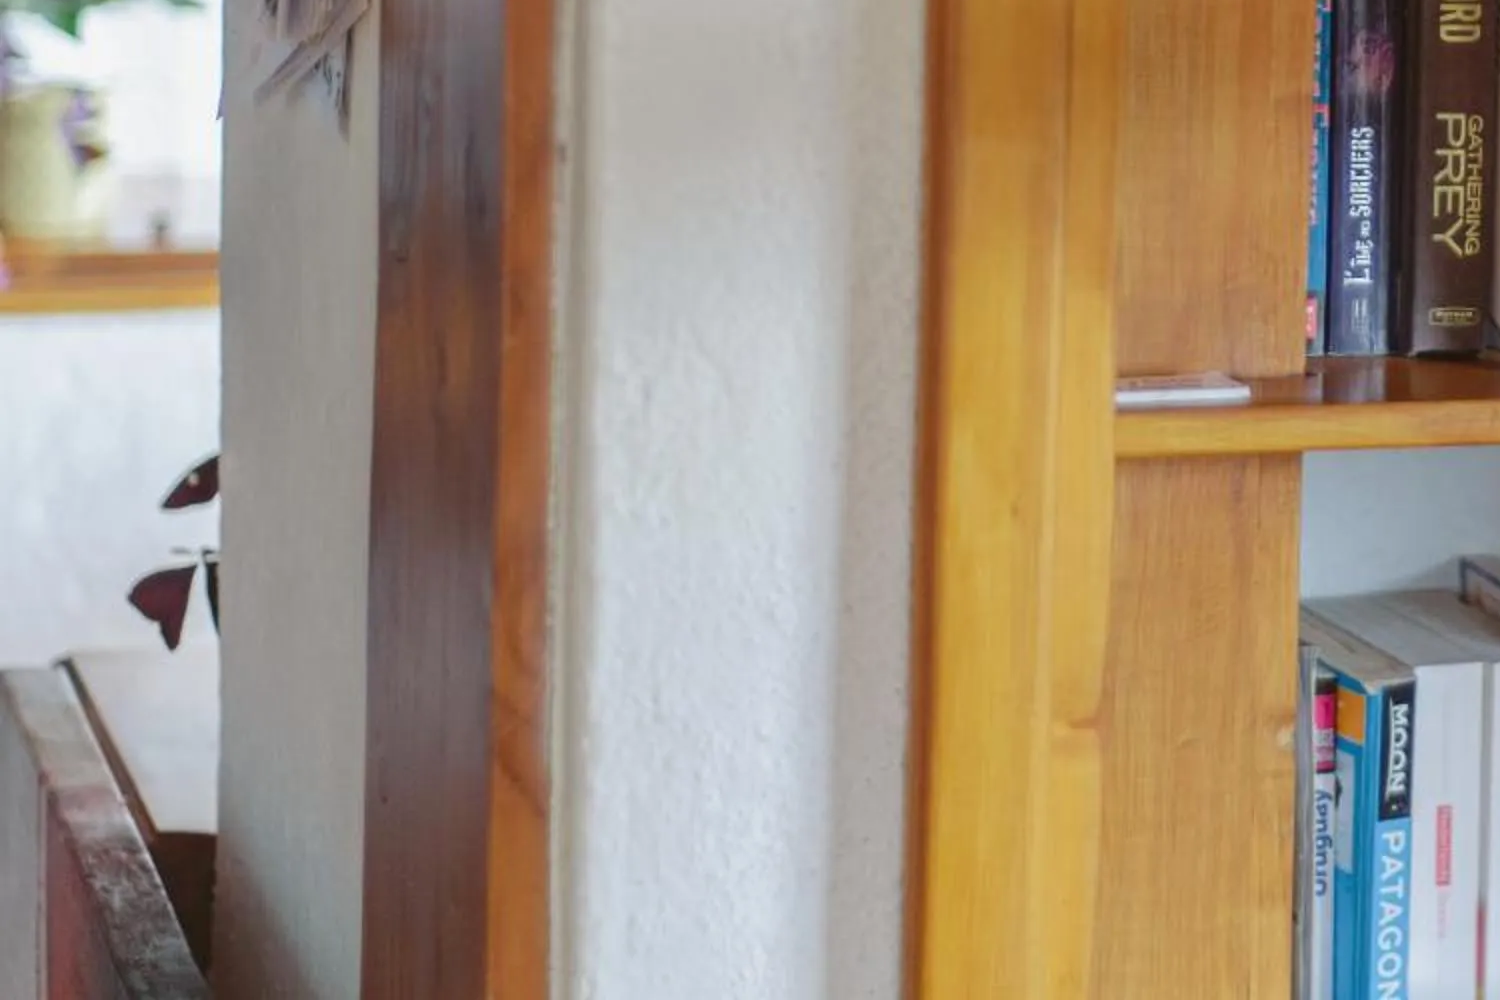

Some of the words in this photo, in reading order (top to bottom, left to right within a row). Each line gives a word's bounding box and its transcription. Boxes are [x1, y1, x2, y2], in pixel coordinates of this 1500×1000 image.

[1349, 126, 1374, 217] SORCIERS
[1432, 112, 1465, 258] PREY
[1465, 115, 1484, 256] GATHERING
[1390, 703, 1409, 792] MOON
[1314, 790, 1332, 897] Uruguay
[1376, 830, 1406, 1000] PATAGON
